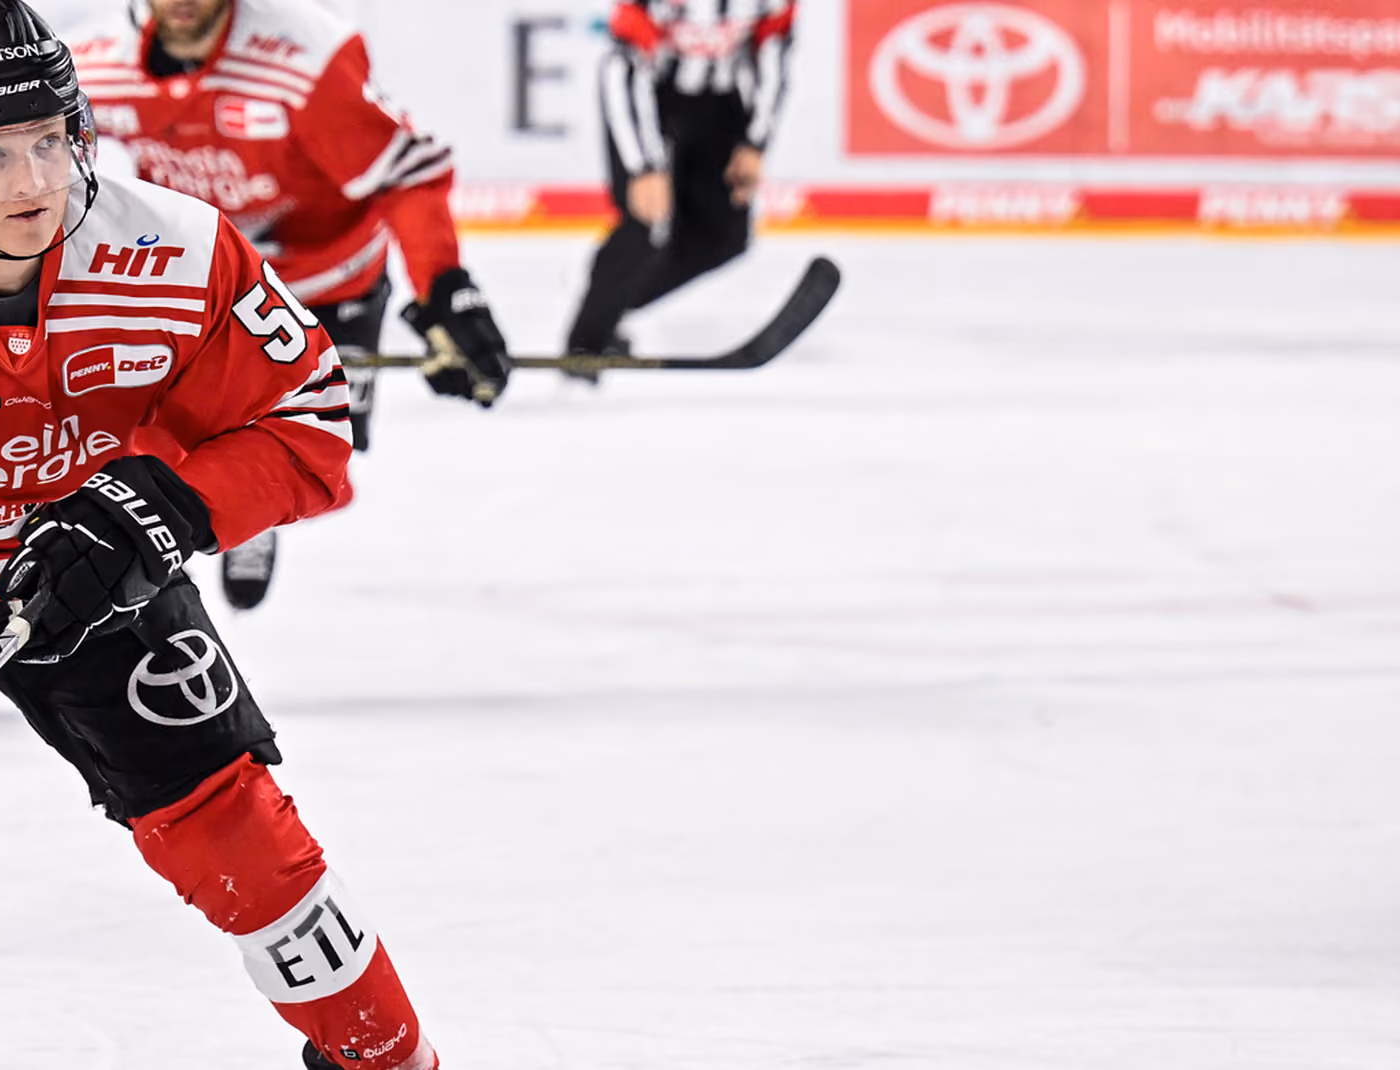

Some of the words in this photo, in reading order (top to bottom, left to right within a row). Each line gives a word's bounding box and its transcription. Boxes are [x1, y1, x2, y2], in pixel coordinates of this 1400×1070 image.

[88, 234, 185, 277] HIT
[80, 472, 182, 577] BAUER
[265, 895, 365, 989] ETL
